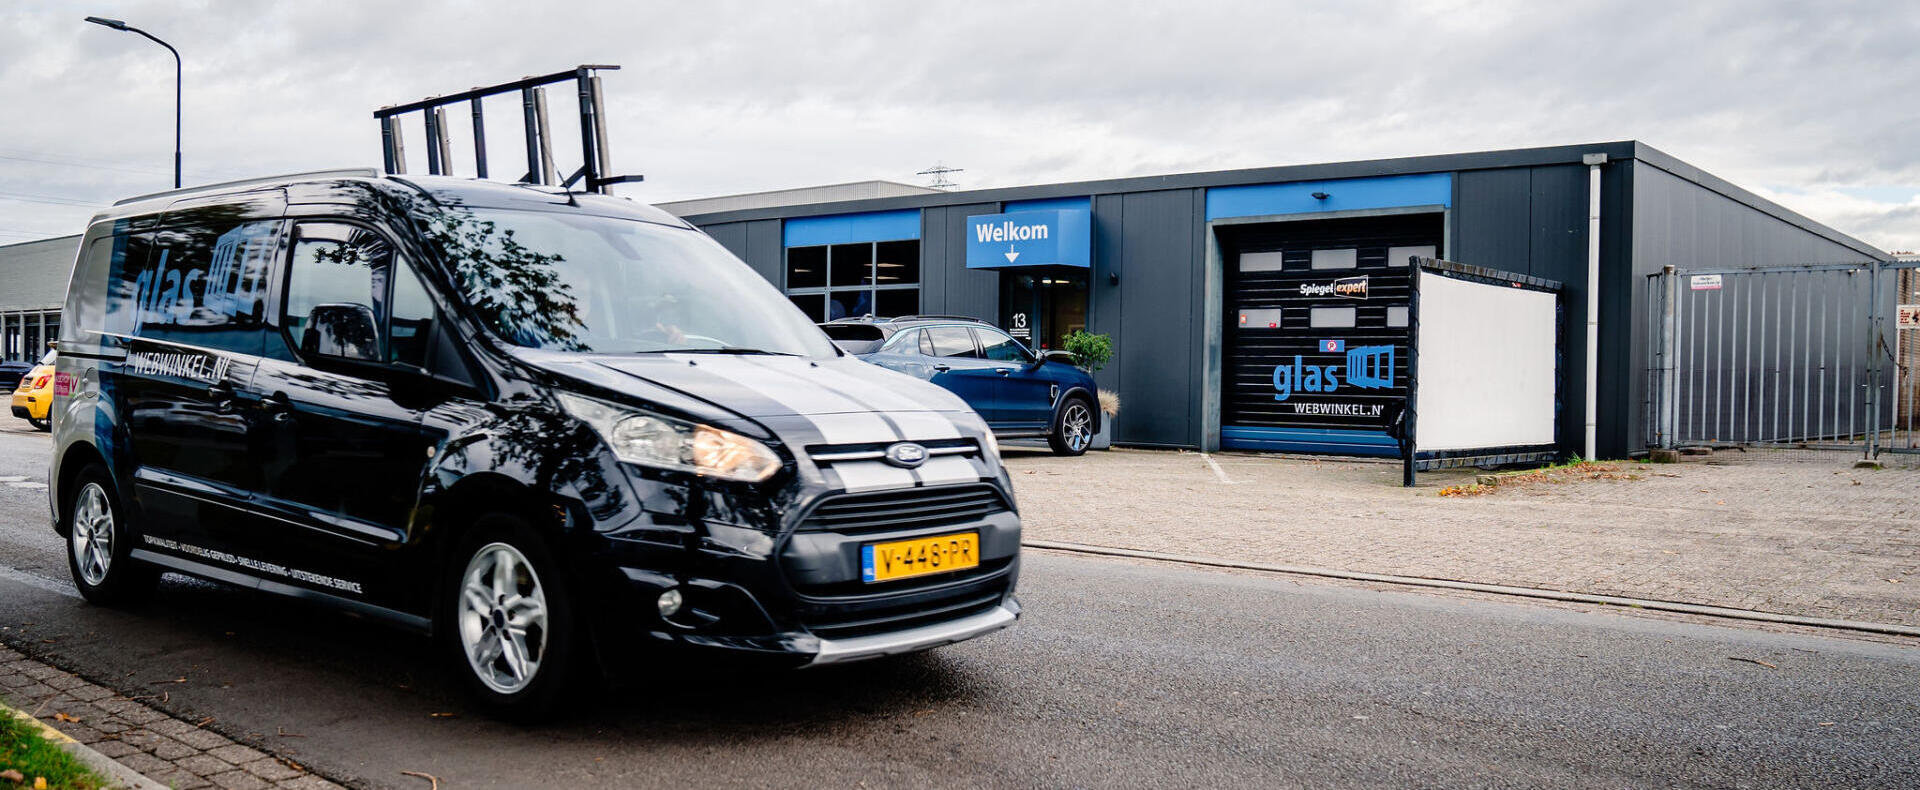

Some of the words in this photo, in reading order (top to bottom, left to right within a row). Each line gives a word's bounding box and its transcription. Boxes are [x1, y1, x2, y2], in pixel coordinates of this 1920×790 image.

[976, 221, 1048, 243] Welkom
[125, 248, 201, 341] glas
[1300, 283, 1334, 296] Spiegel
[1336, 280, 1367, 295] expert
[1012, 313, 1026, 328] 13
[134, 351, 231, 379] WEBWINKEL.NL
[1273, 355, 1338, 401] glas
[1294, 403, 1384, 416] WEBWINKEL.N
[881, 540, 972, 573] V-448-PR
